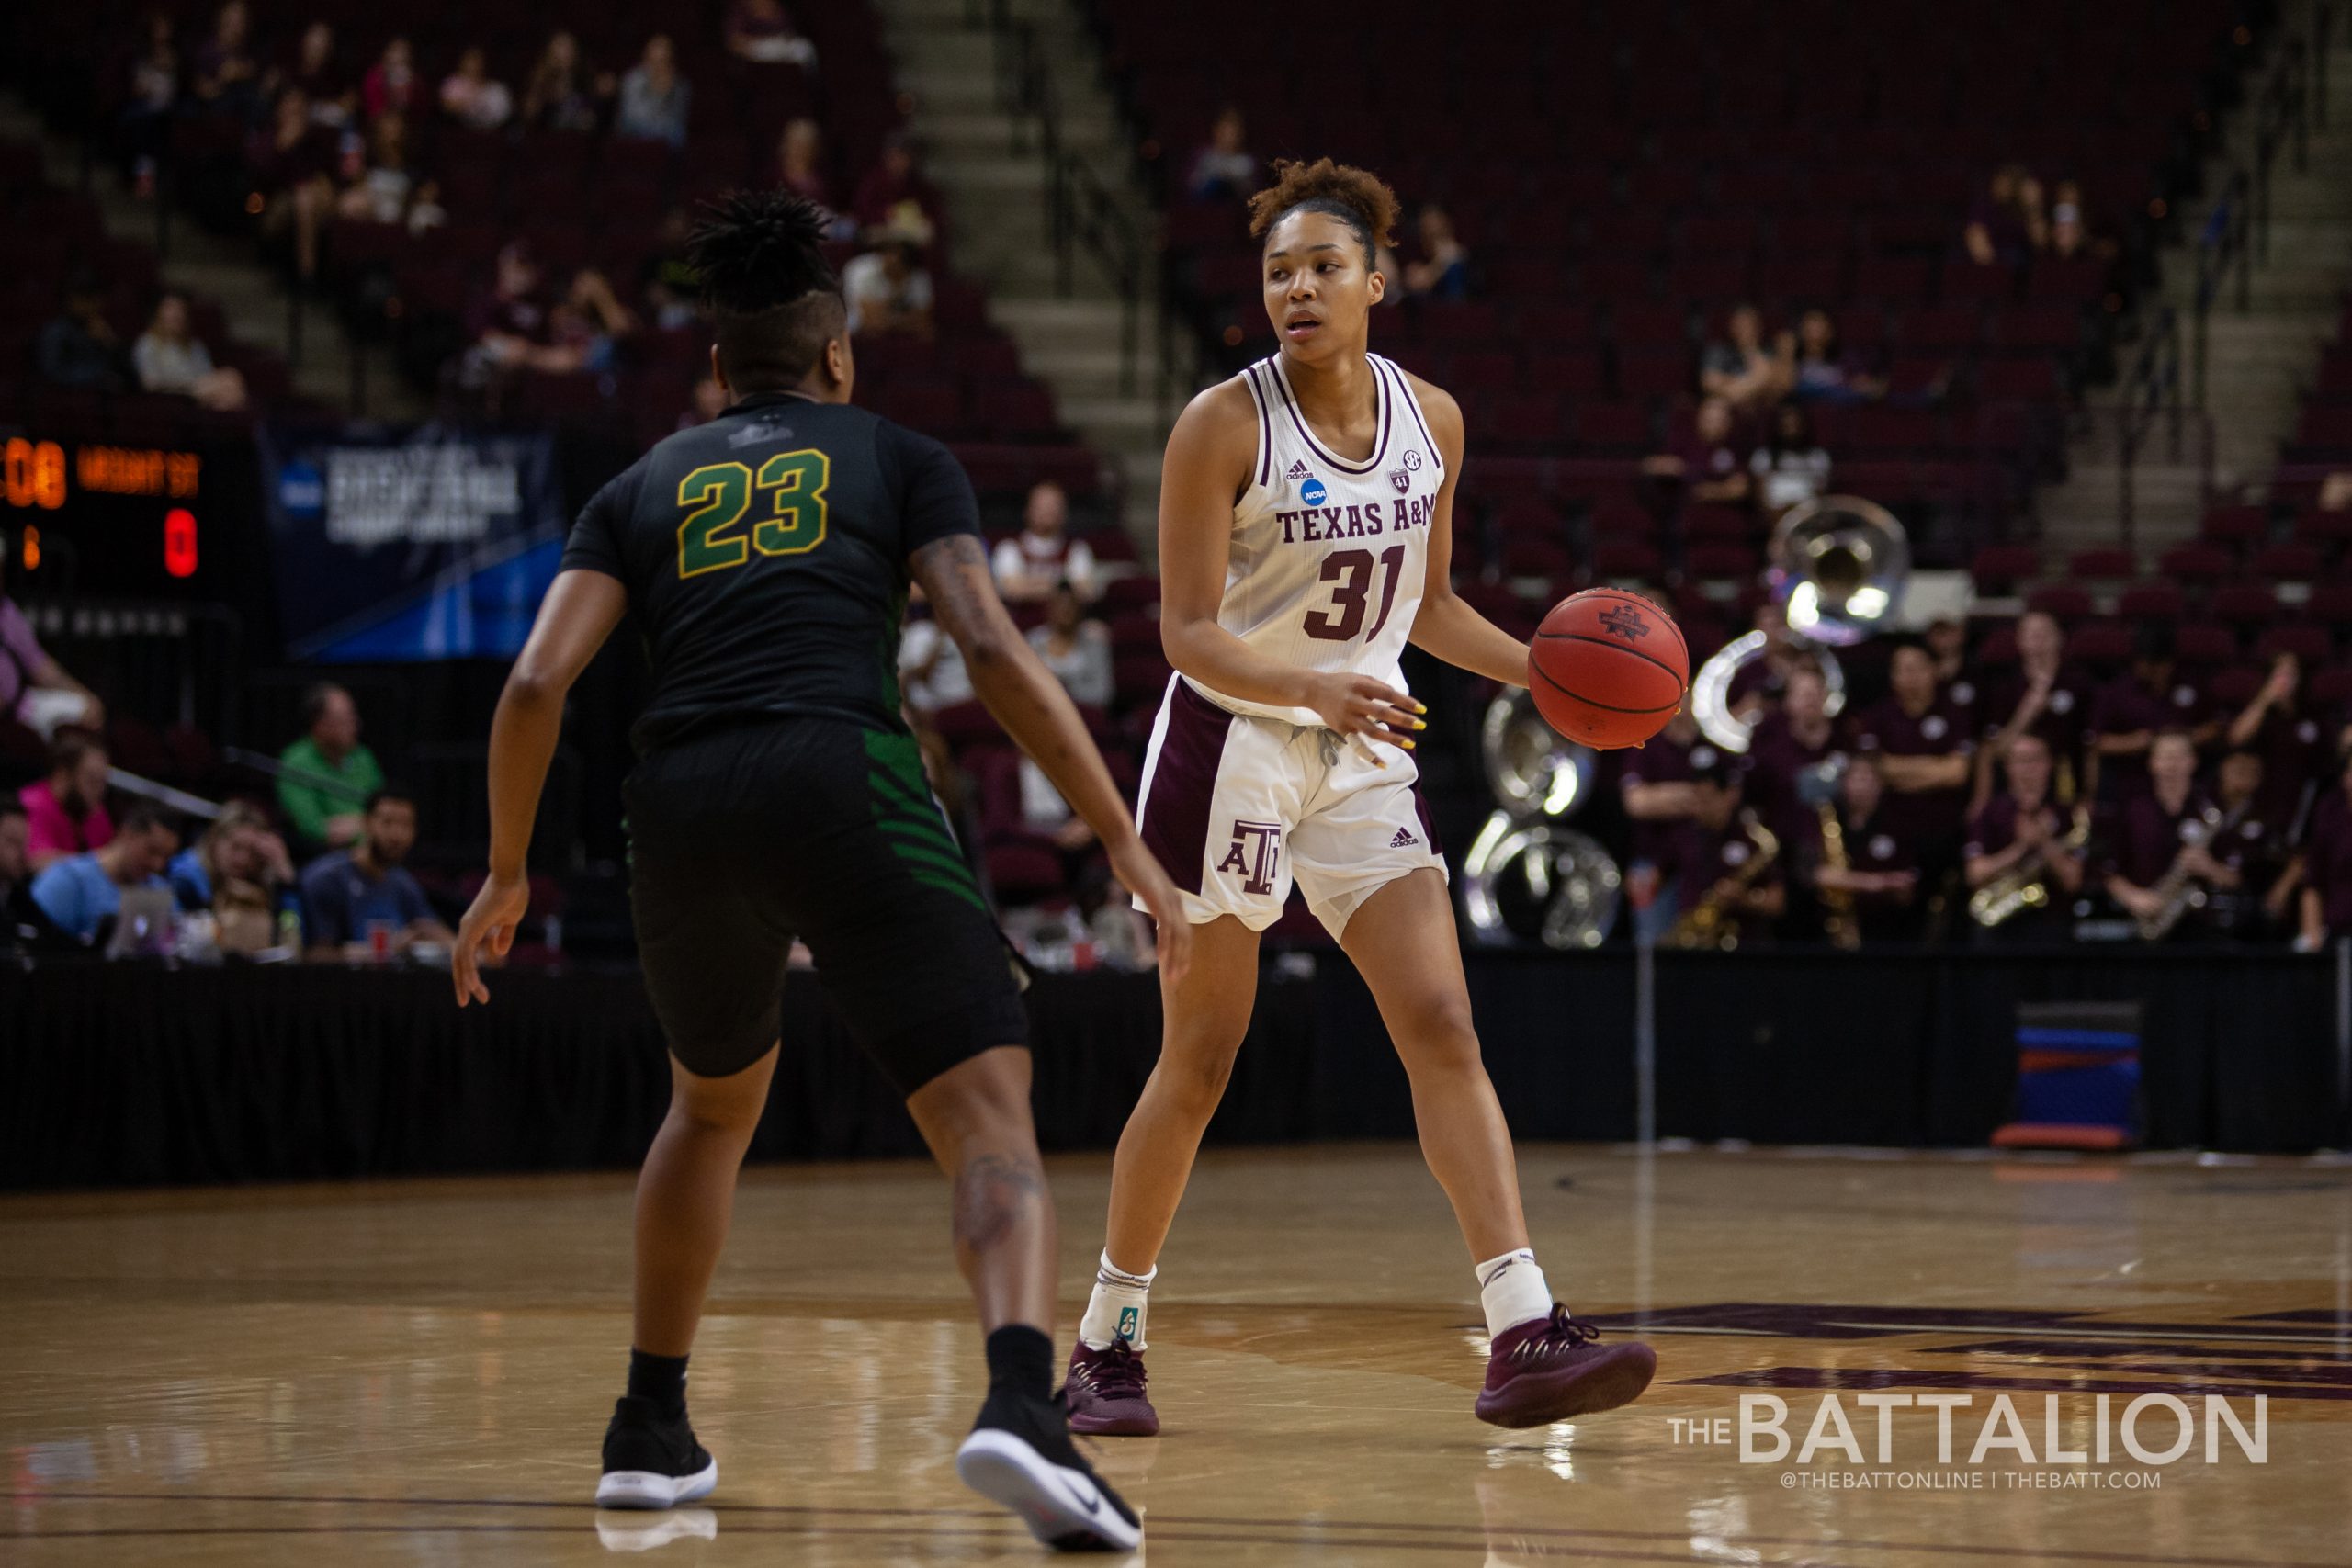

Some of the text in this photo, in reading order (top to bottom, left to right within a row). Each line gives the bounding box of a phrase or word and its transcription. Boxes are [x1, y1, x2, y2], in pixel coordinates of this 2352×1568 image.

[1405, 451, 1421, 470] SEC
[1286, 471, 1314, 479] adidas
[1396, 477, 1408, 487] 41
[1306, 490, 1327, 501] NCAA
[677, 448, 831, 580] 23
[1276, 493, 1435, 544] TEXAS A&M
[1303, 545, 1406, 644] 31
[1390, 837, 1419, 848] adidas
